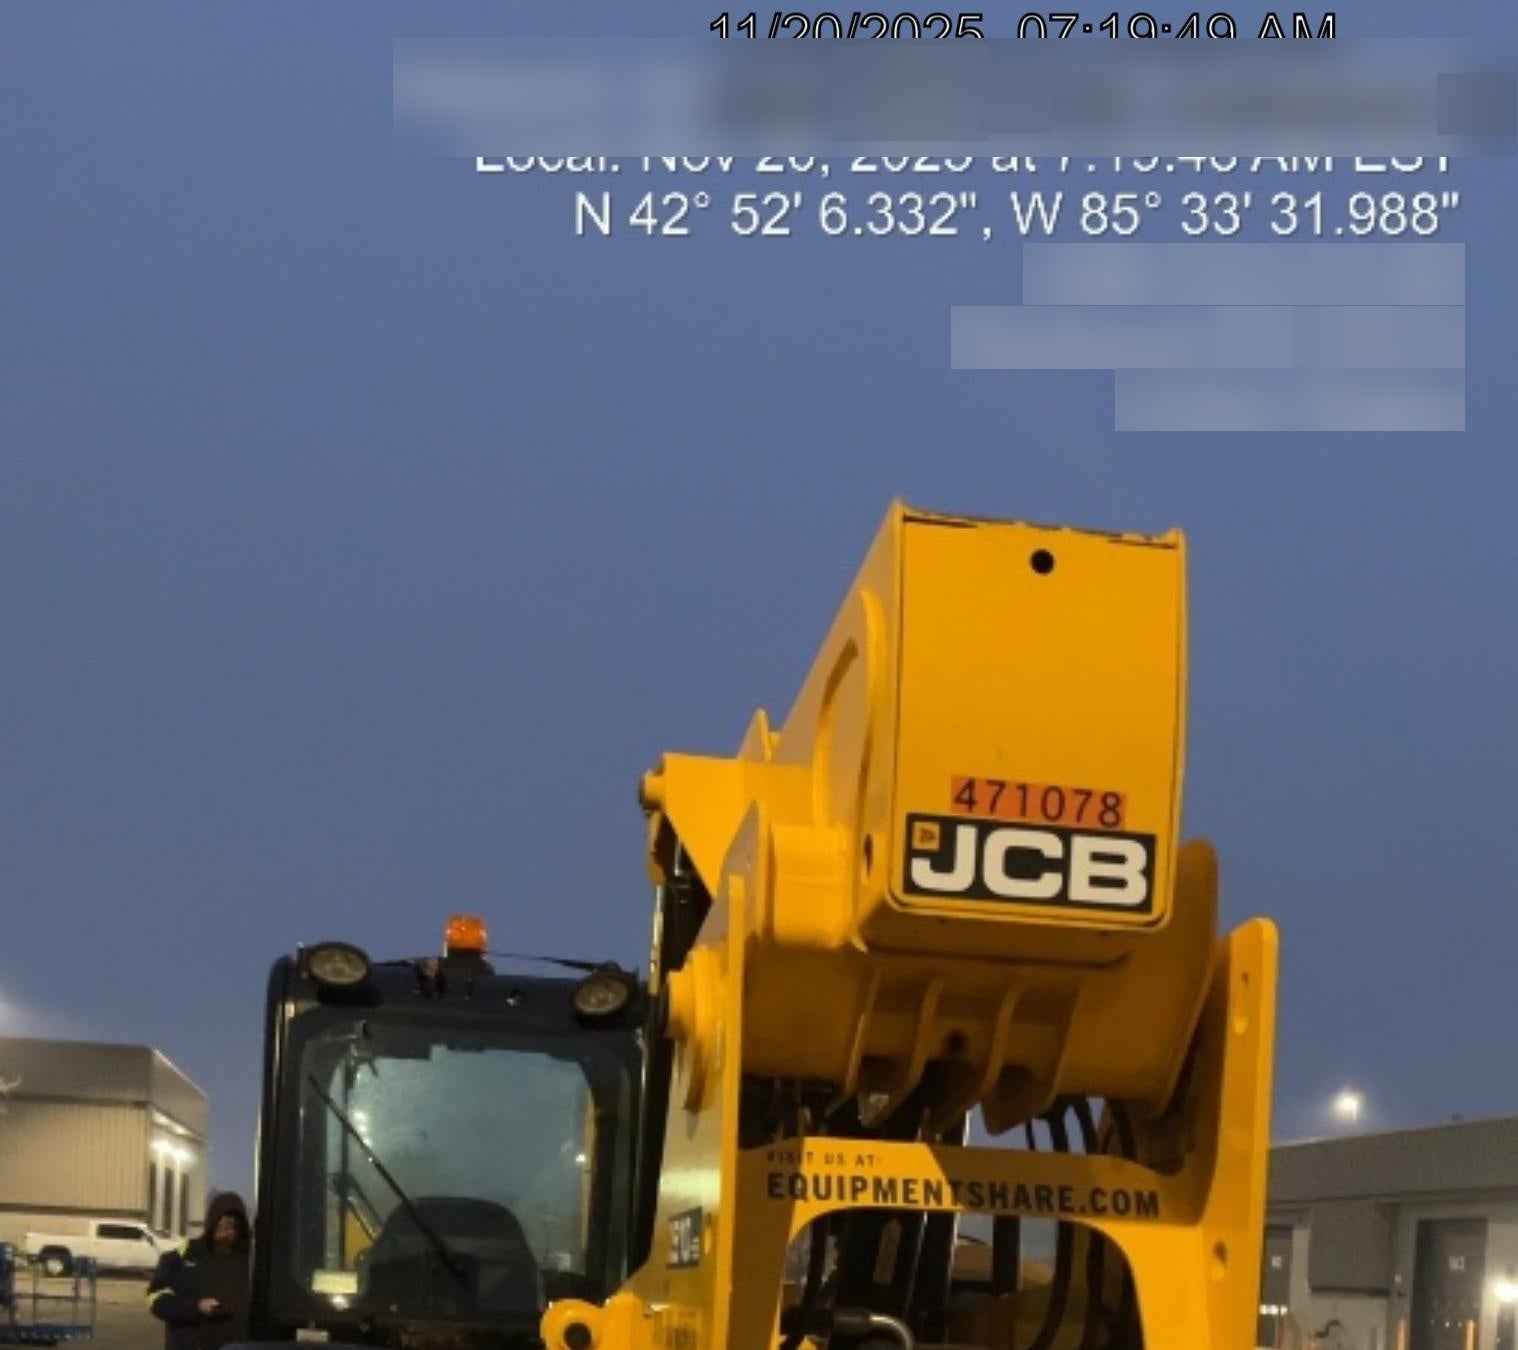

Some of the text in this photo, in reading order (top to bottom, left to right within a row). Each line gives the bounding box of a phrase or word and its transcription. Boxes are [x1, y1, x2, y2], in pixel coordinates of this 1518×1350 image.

[953, 777, 1125, 829] 471078
[910, 824, 1149, 906] JCB
[824, 1151, 847, 1167] US
[766, 1171, 1160, 1219] EQUIPMENTSHARE.COM
